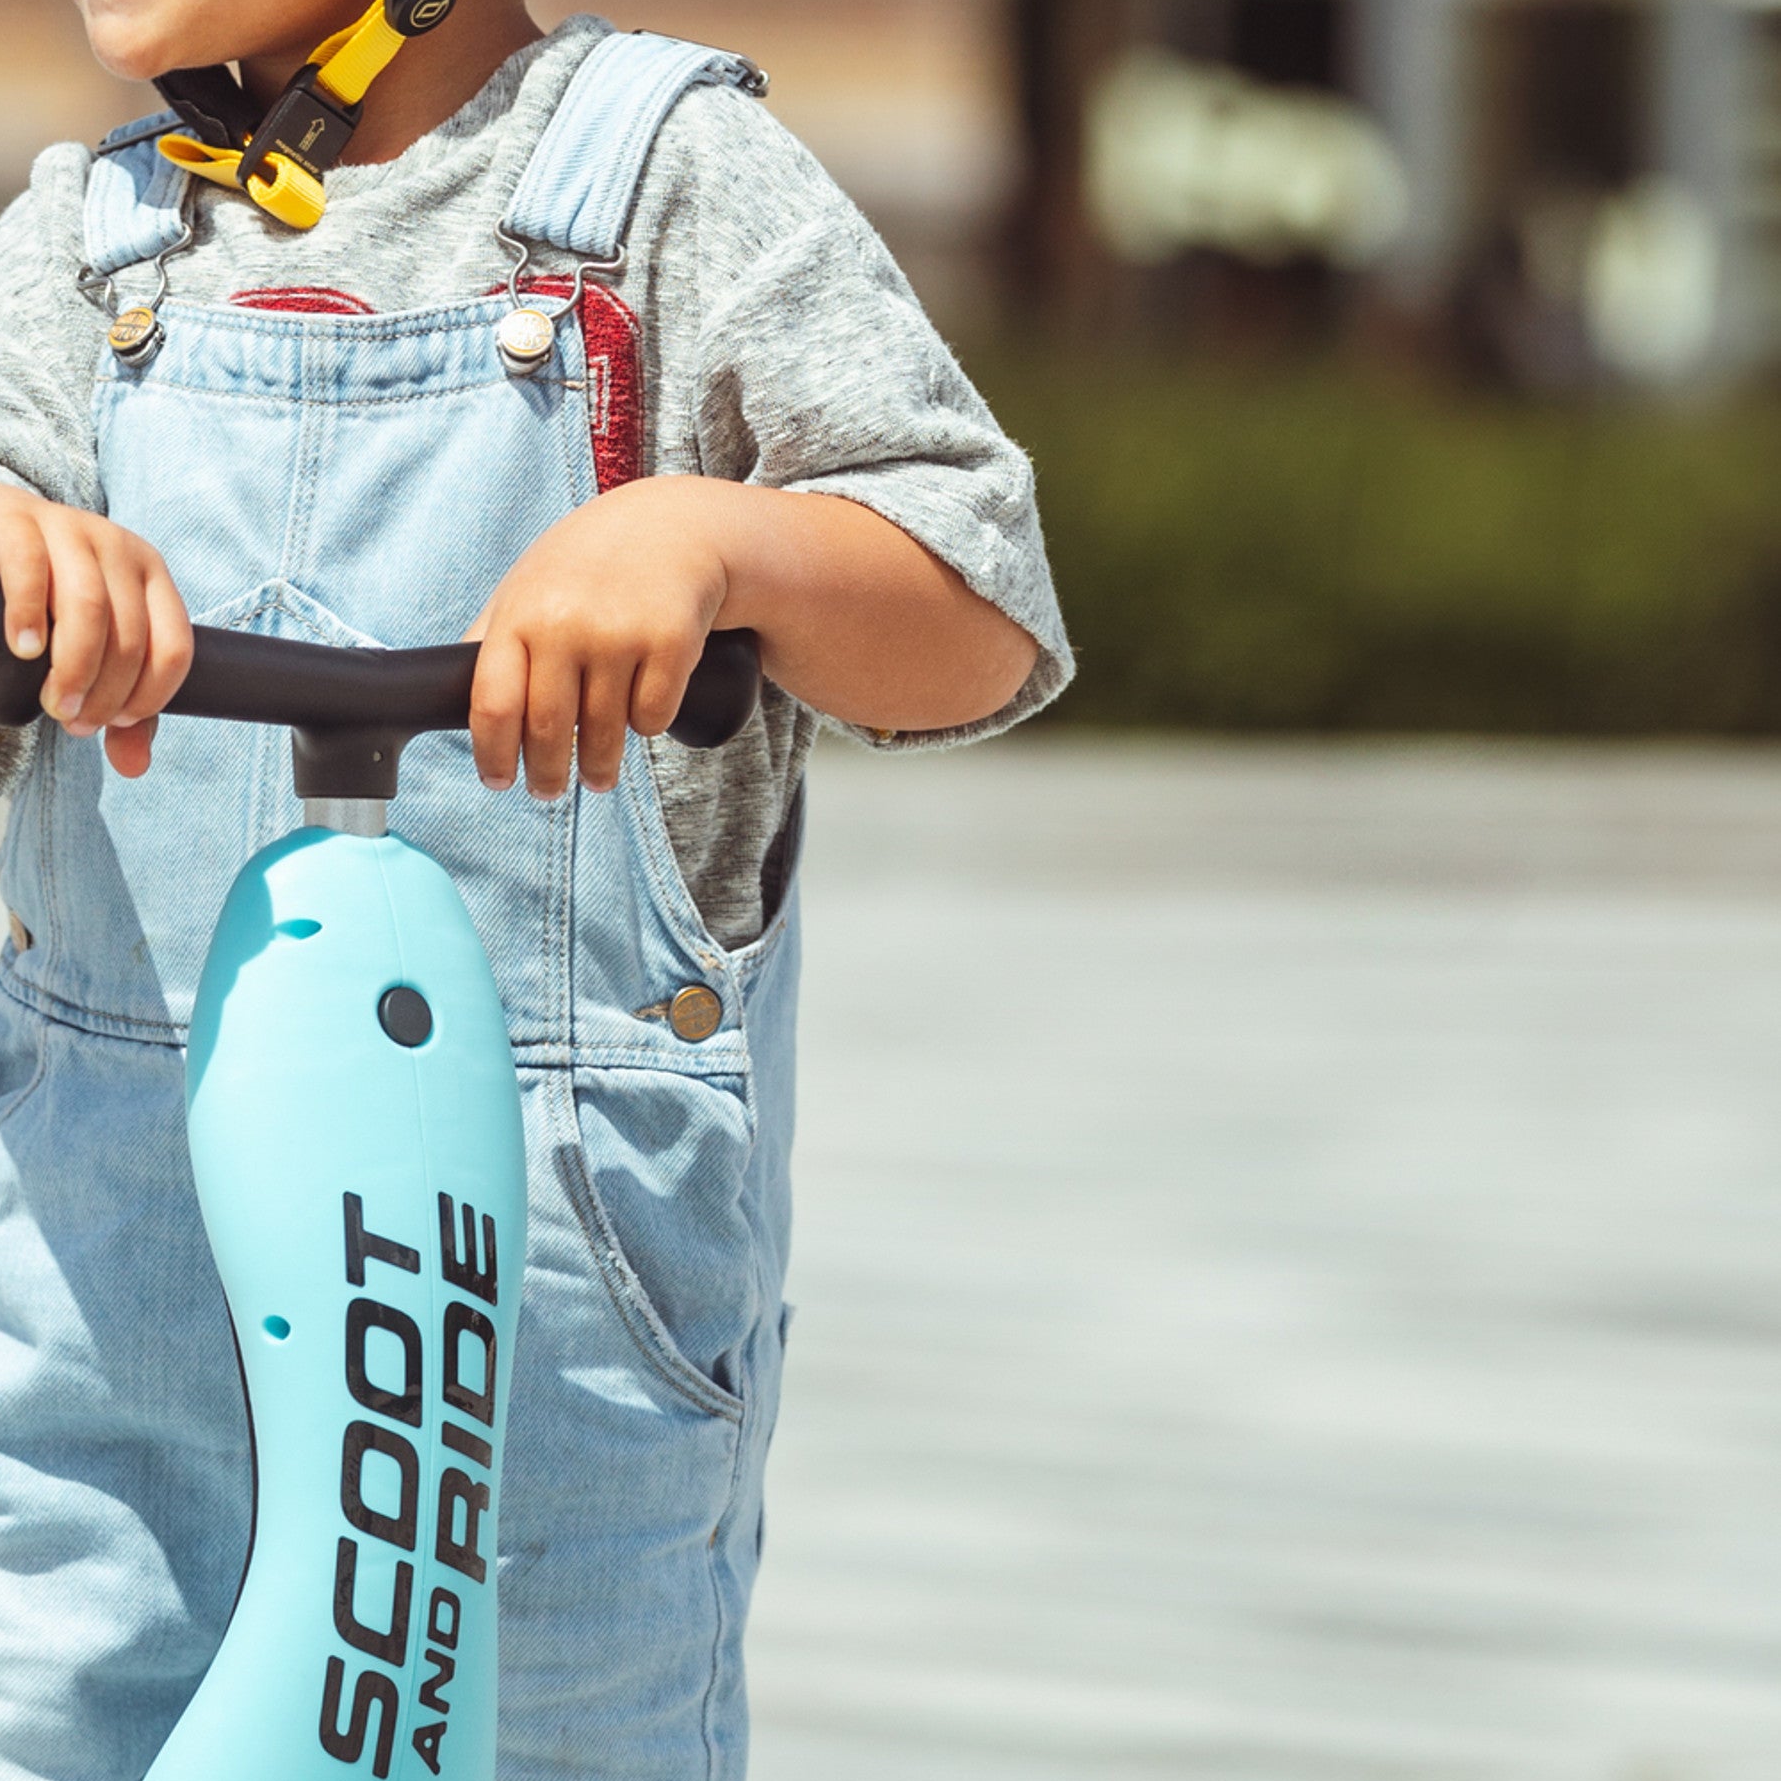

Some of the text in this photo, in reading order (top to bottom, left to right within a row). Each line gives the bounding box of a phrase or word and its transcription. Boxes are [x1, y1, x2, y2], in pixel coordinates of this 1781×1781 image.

[319, 1191, 422, 1779] SCOOT
[412, 1191, 498, 1775] AND RIDE
